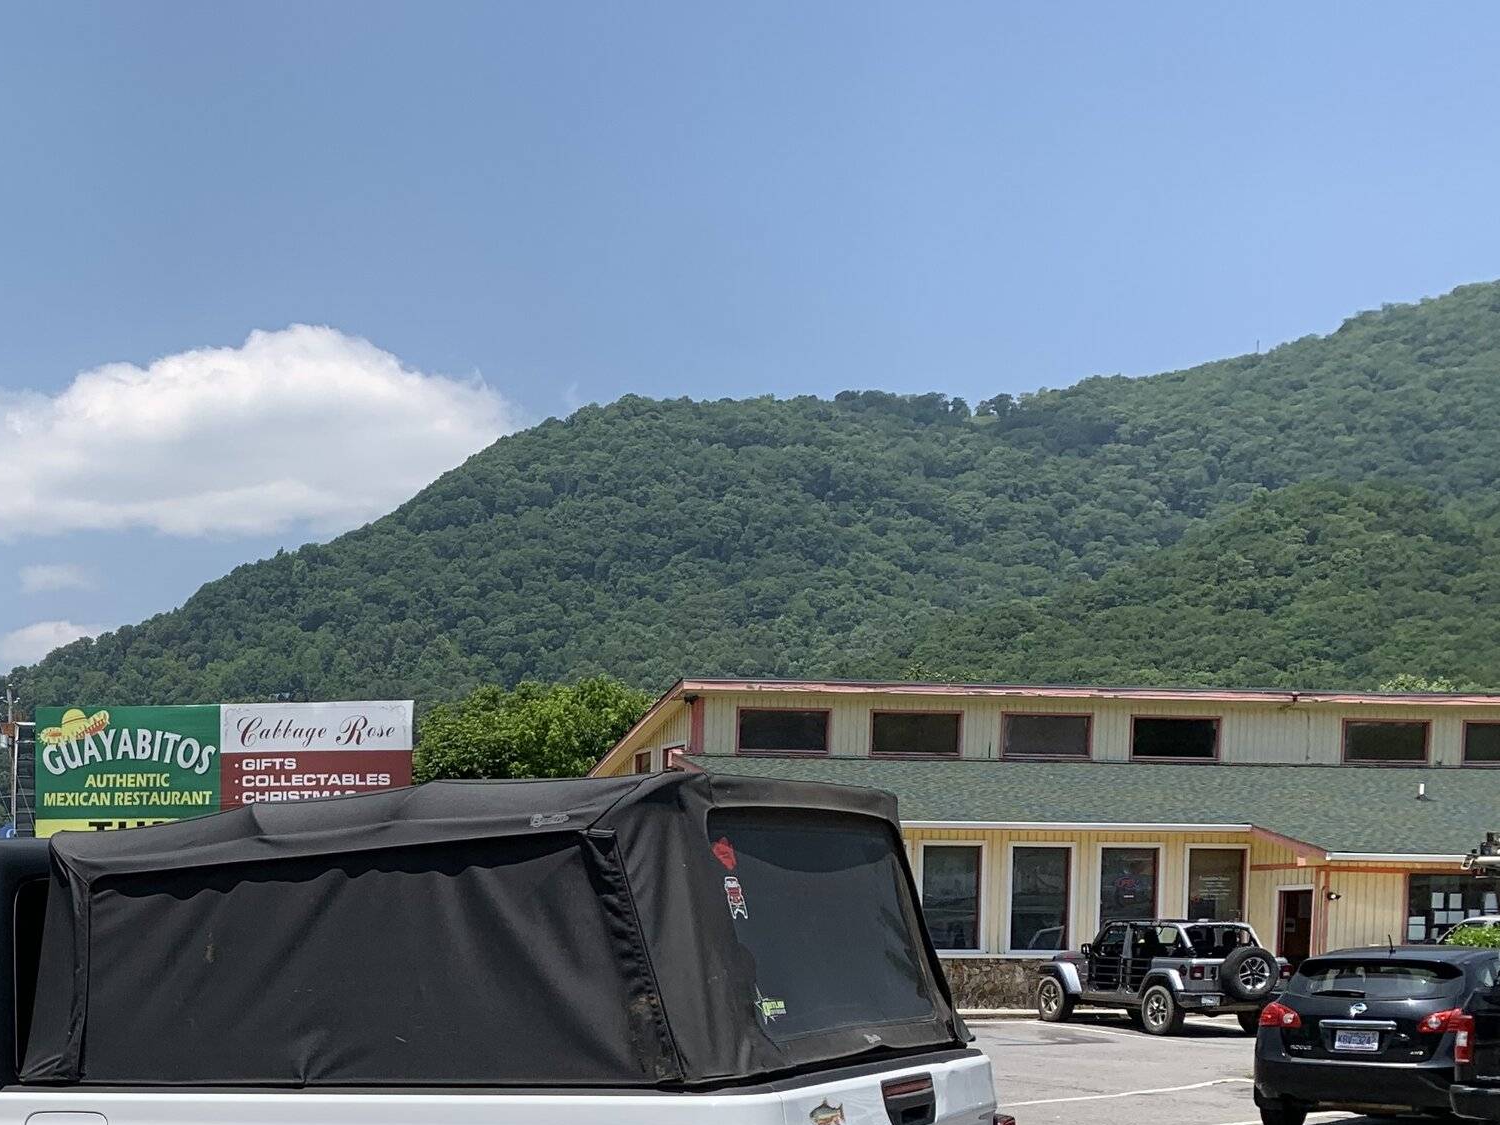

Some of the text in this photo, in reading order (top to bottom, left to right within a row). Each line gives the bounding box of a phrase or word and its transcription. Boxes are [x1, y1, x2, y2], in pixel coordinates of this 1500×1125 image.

[237, 714, 396, 748] Cabbage Rose
[42, 728, 217, 775] GUAYABITOS
[242, 758, 297, 770] GIFTS
[84, 773, 170, 788] AUTHENTIC
[242, 773, 391, 787] COLLECTABLES
[43, 790, 213, 806] MEXICAN RESTAURANT
